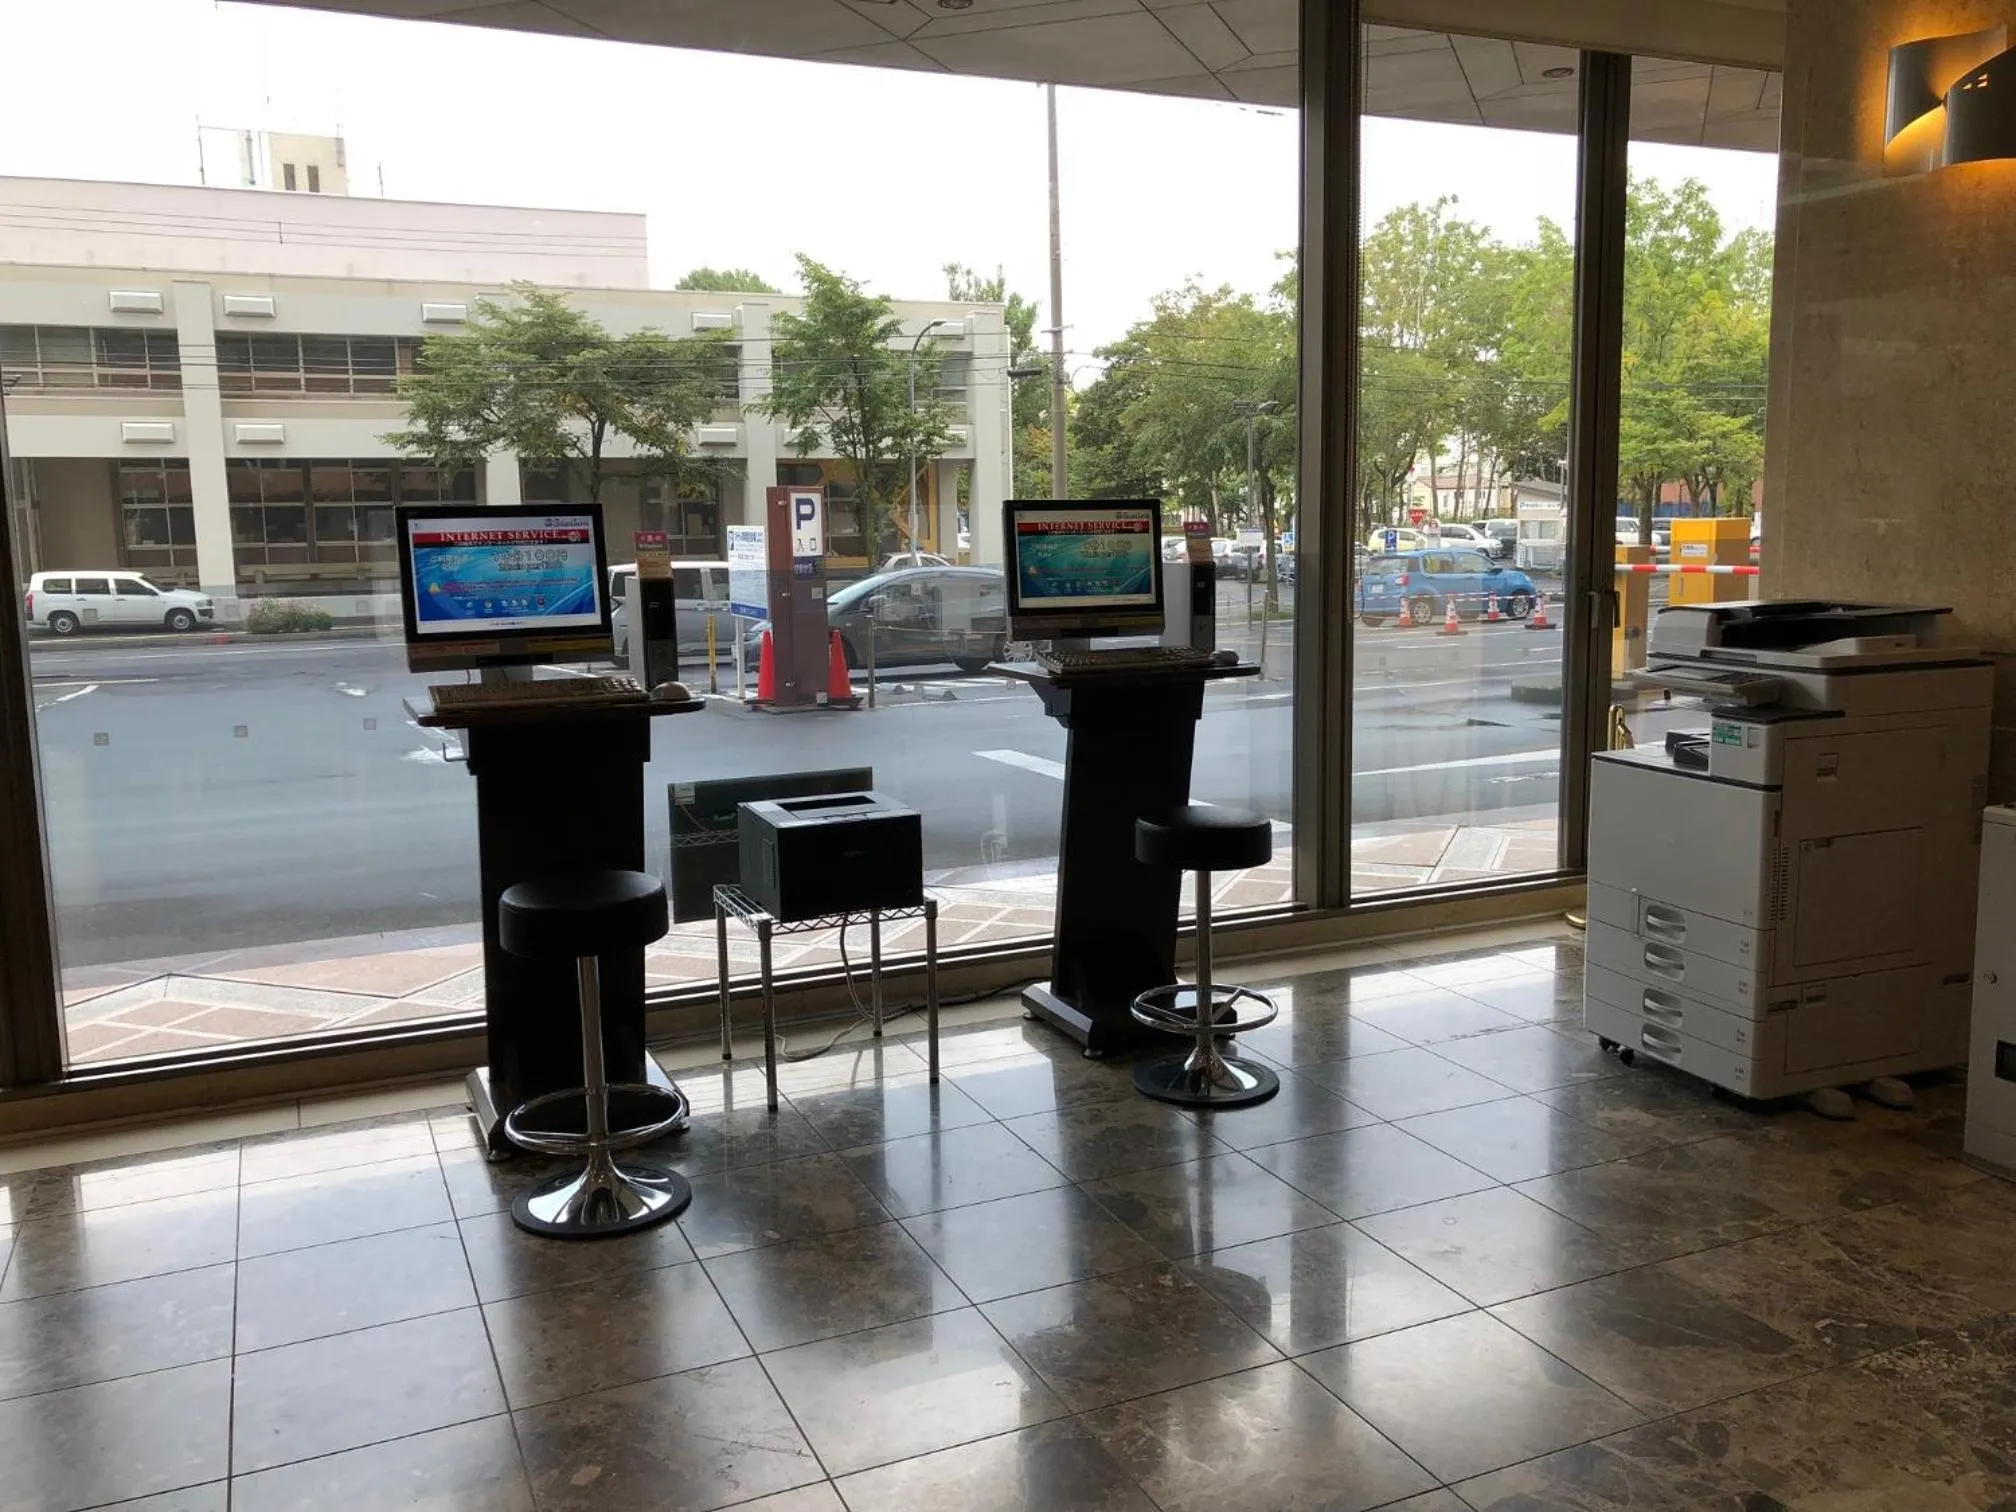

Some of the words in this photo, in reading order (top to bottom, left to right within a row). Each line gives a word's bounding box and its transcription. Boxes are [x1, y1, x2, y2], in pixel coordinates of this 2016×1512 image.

[796, 498, 816, 529] P
[1038, 521, 1085, 531] INTERNET
[1088, 520, 1126, 530] SERVICE
[440, 531, 502, 543] INTERNET
[508, 530, 559, 541] SERVICE
[796, 538, 817, 552] 入口
